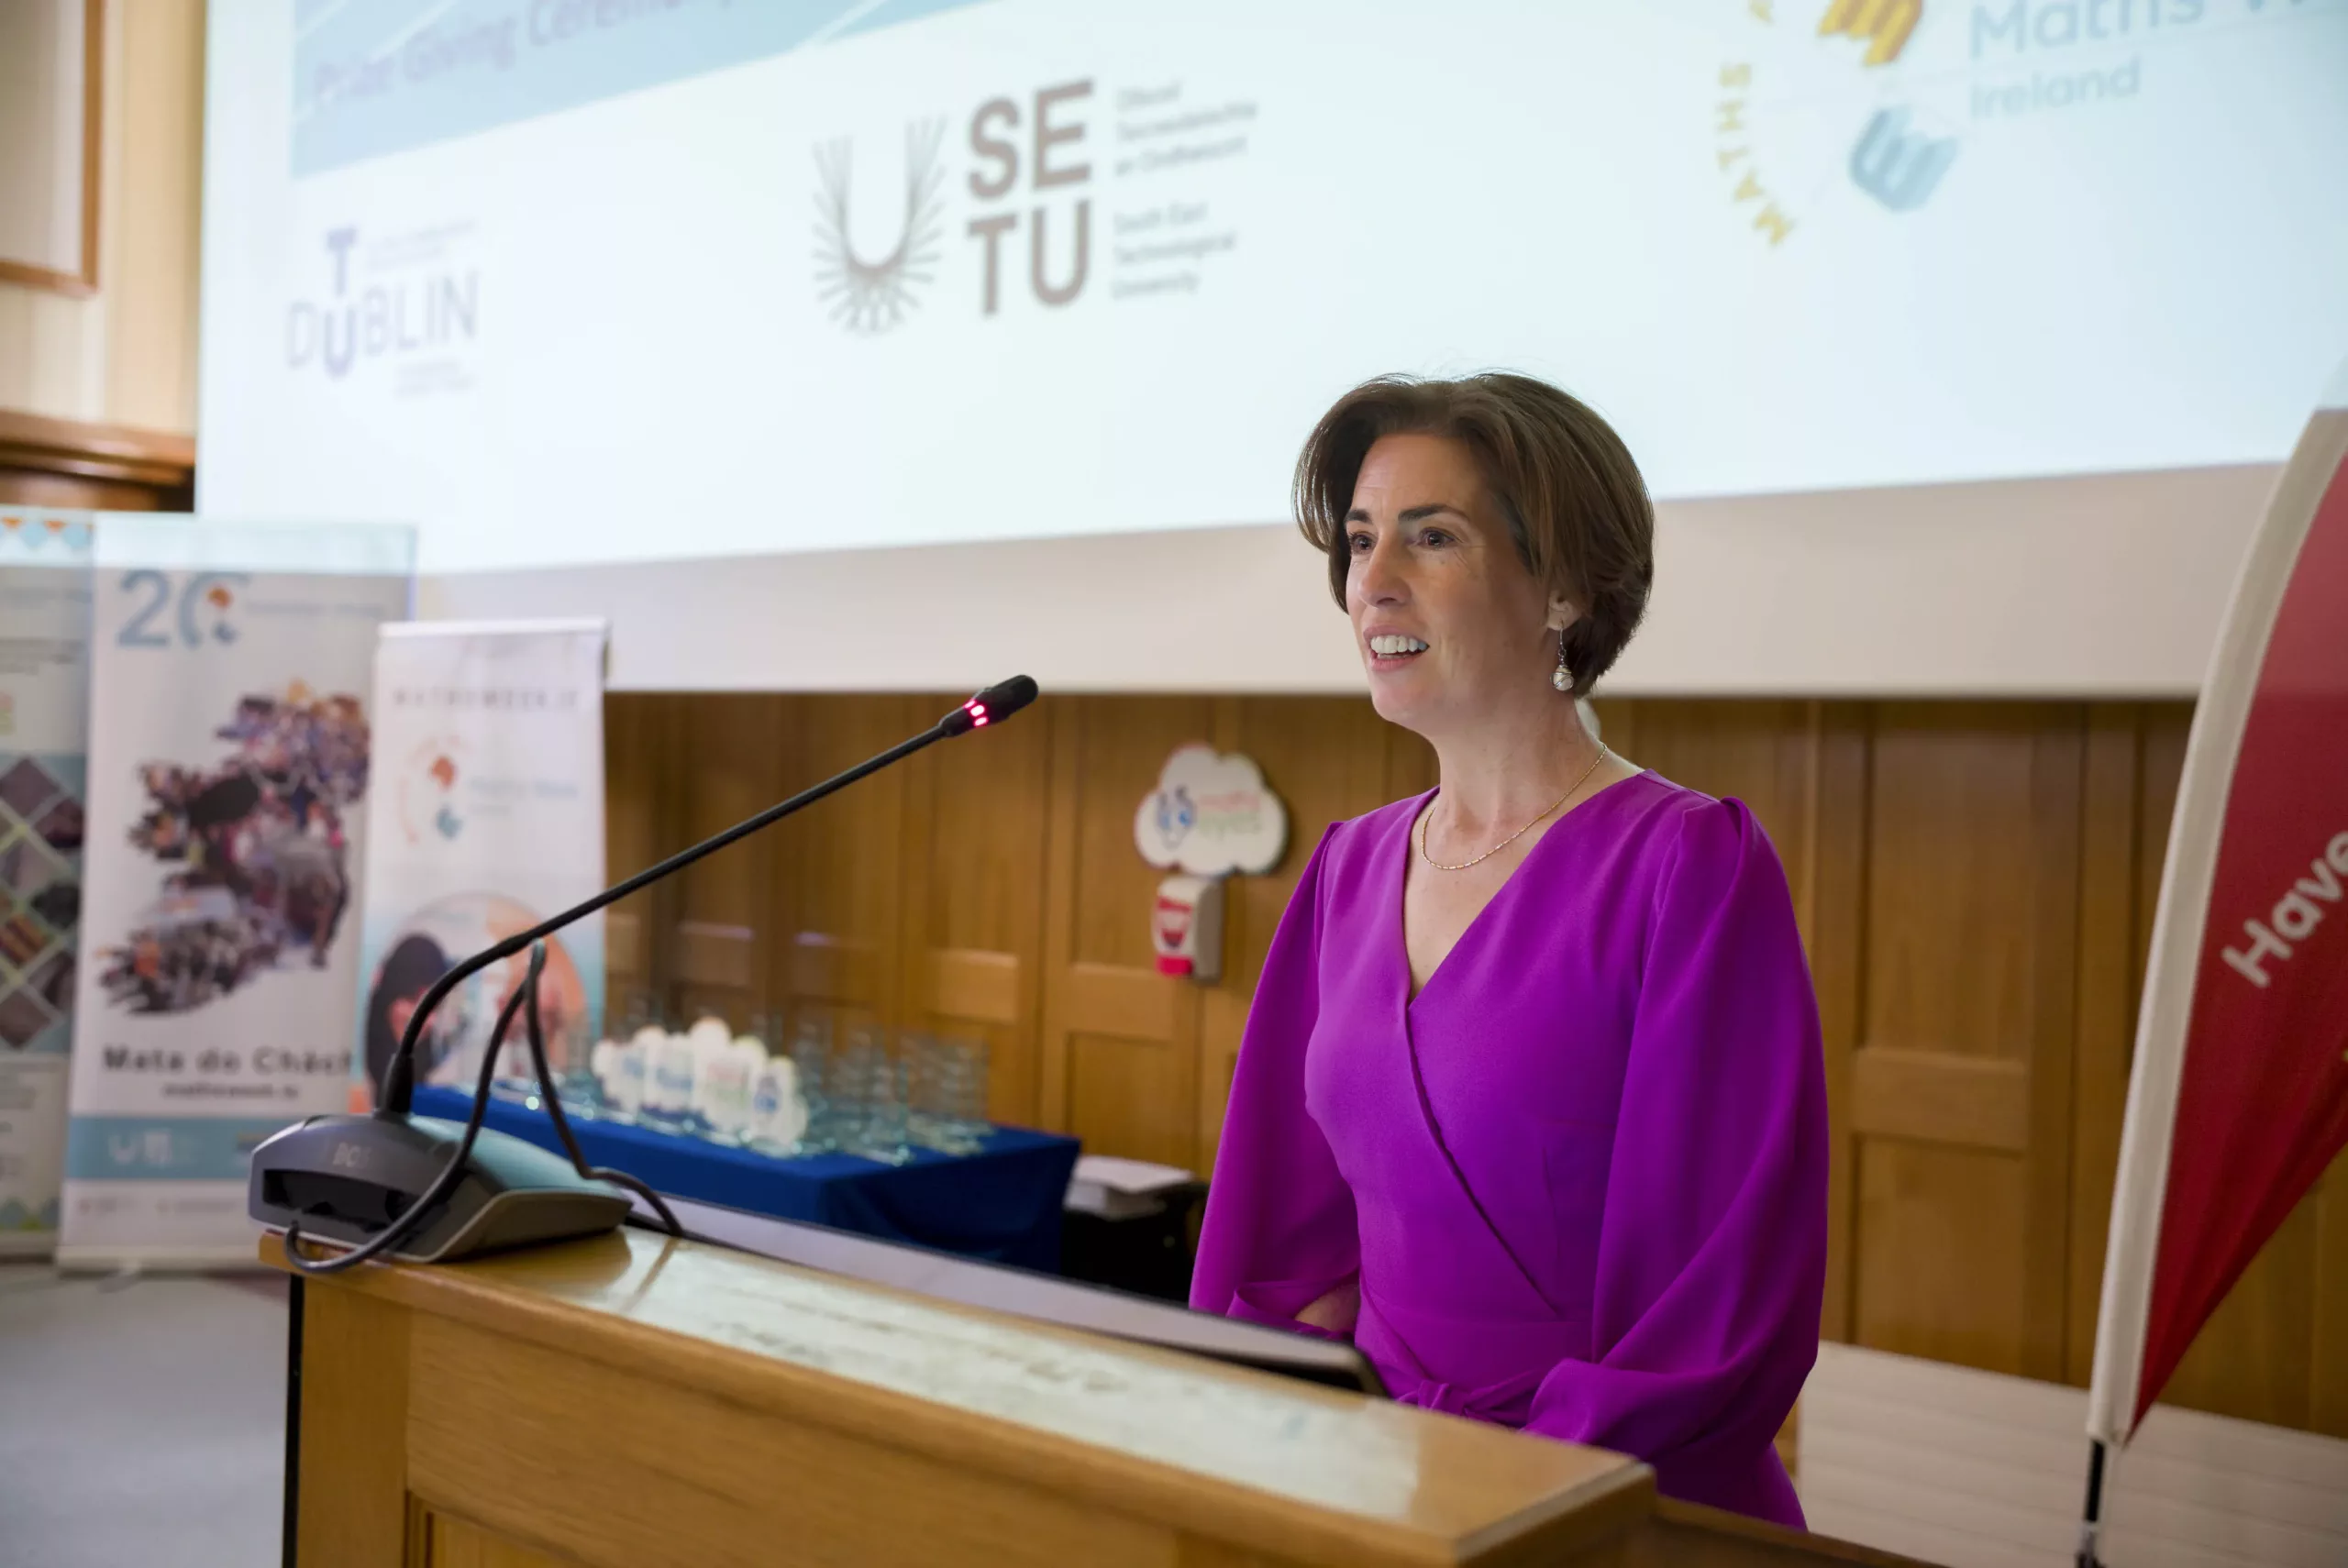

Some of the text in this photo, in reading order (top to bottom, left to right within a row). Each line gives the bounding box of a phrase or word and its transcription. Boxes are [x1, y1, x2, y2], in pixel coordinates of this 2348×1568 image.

[967, 79, 1094, 201] SE
[1970, 53, 2142, 118] Ireland
[967, 199, 1091, 316] TU
[2220, 830, 2348, 988] Have
